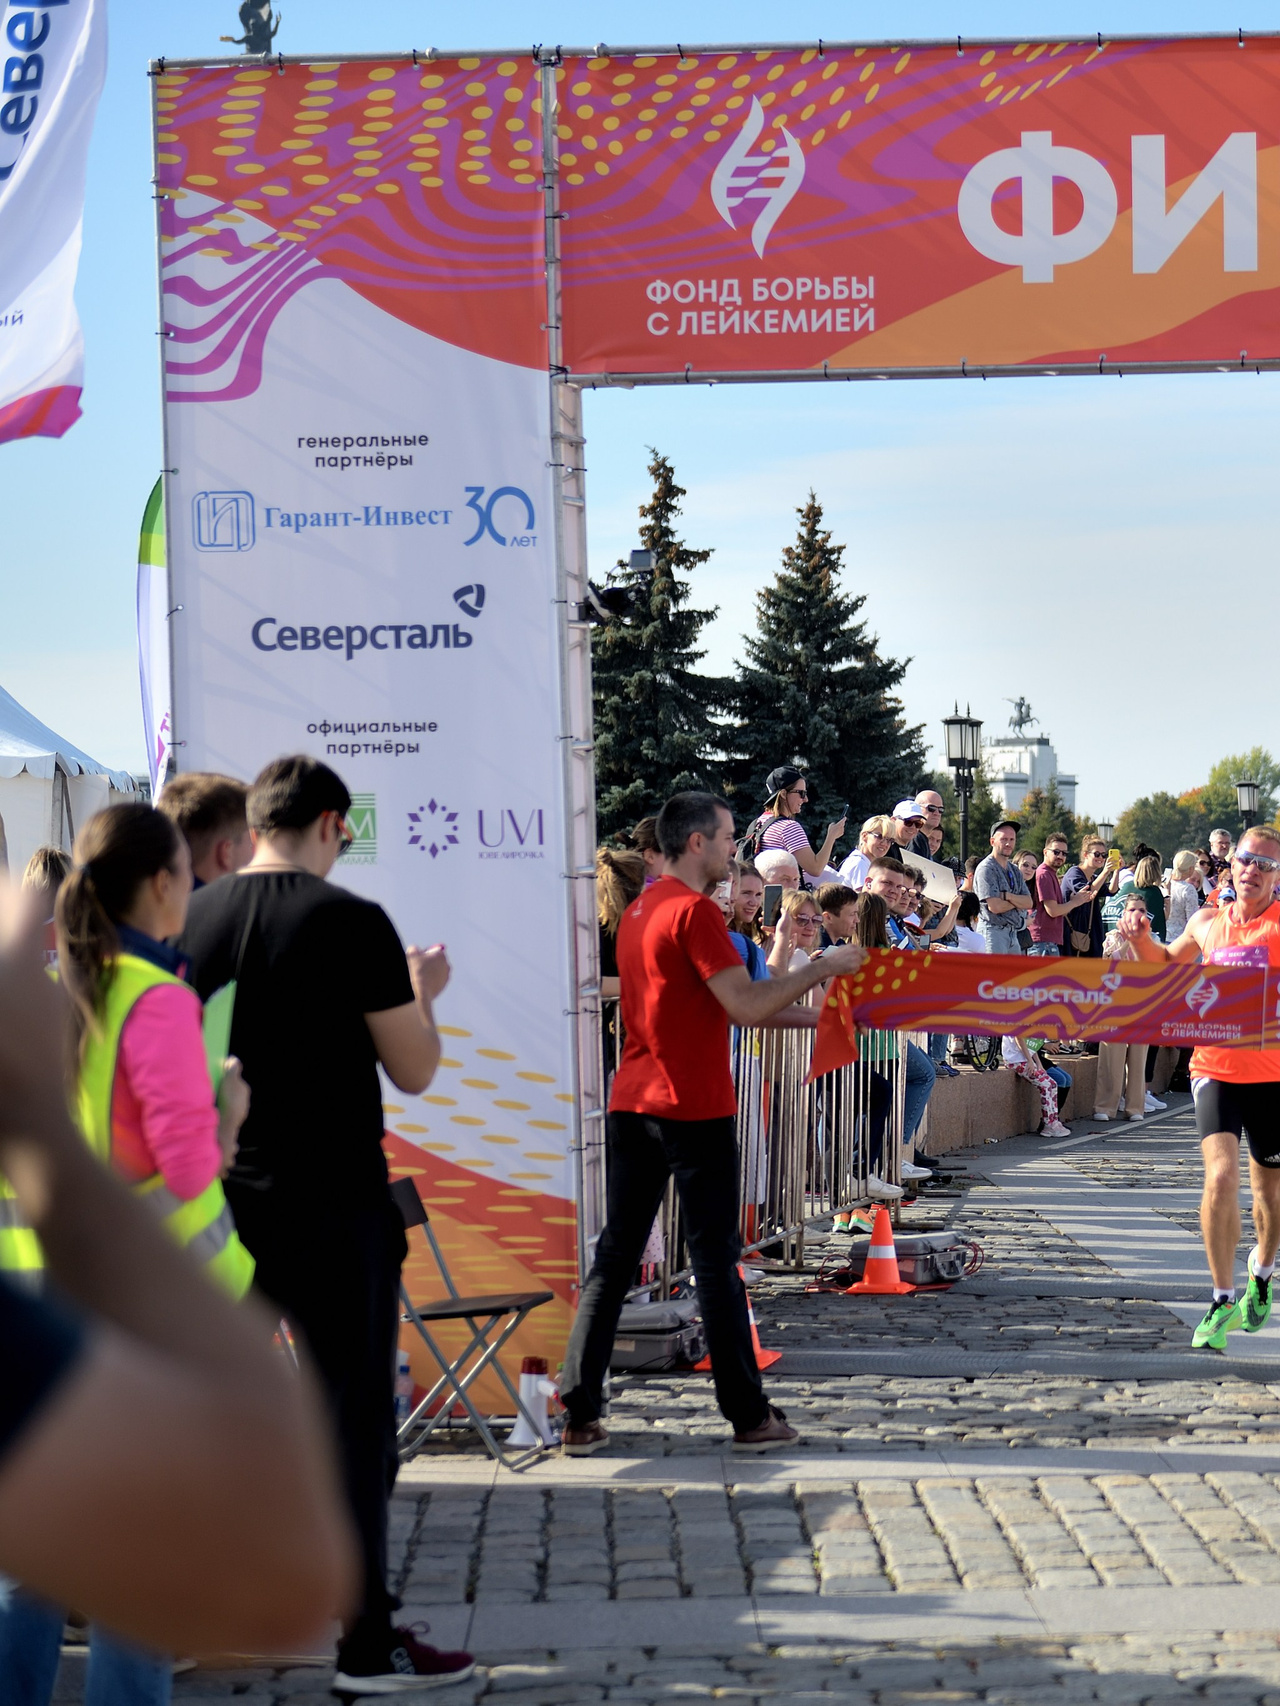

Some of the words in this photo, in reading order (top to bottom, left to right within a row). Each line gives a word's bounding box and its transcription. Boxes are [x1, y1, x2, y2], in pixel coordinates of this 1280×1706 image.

[645, 278, 742, 306] ФОНД
[752, 275, 875, 302] БОРЬБЫ
[646, 312, 670, 336] С
[677, 303, 875, 336] ЛЕЙКЕМИЕЙ
[298, 434, 429, 450] генеральные
[315, 452, 413, 471] партнёры
[264, 505, 453, 534] Гарант-Инвест
[464, 486, 536, 547] 30
[510, 535, 538, 547] лет
[252, 617, 473, 661] Северсталь
[307, 719, 438, 737] официальные
[326, 740, 420, 757] партнёры
[477, 808, 544, 848] UVI
[977, 980, 1113, 1006] Северсталь
